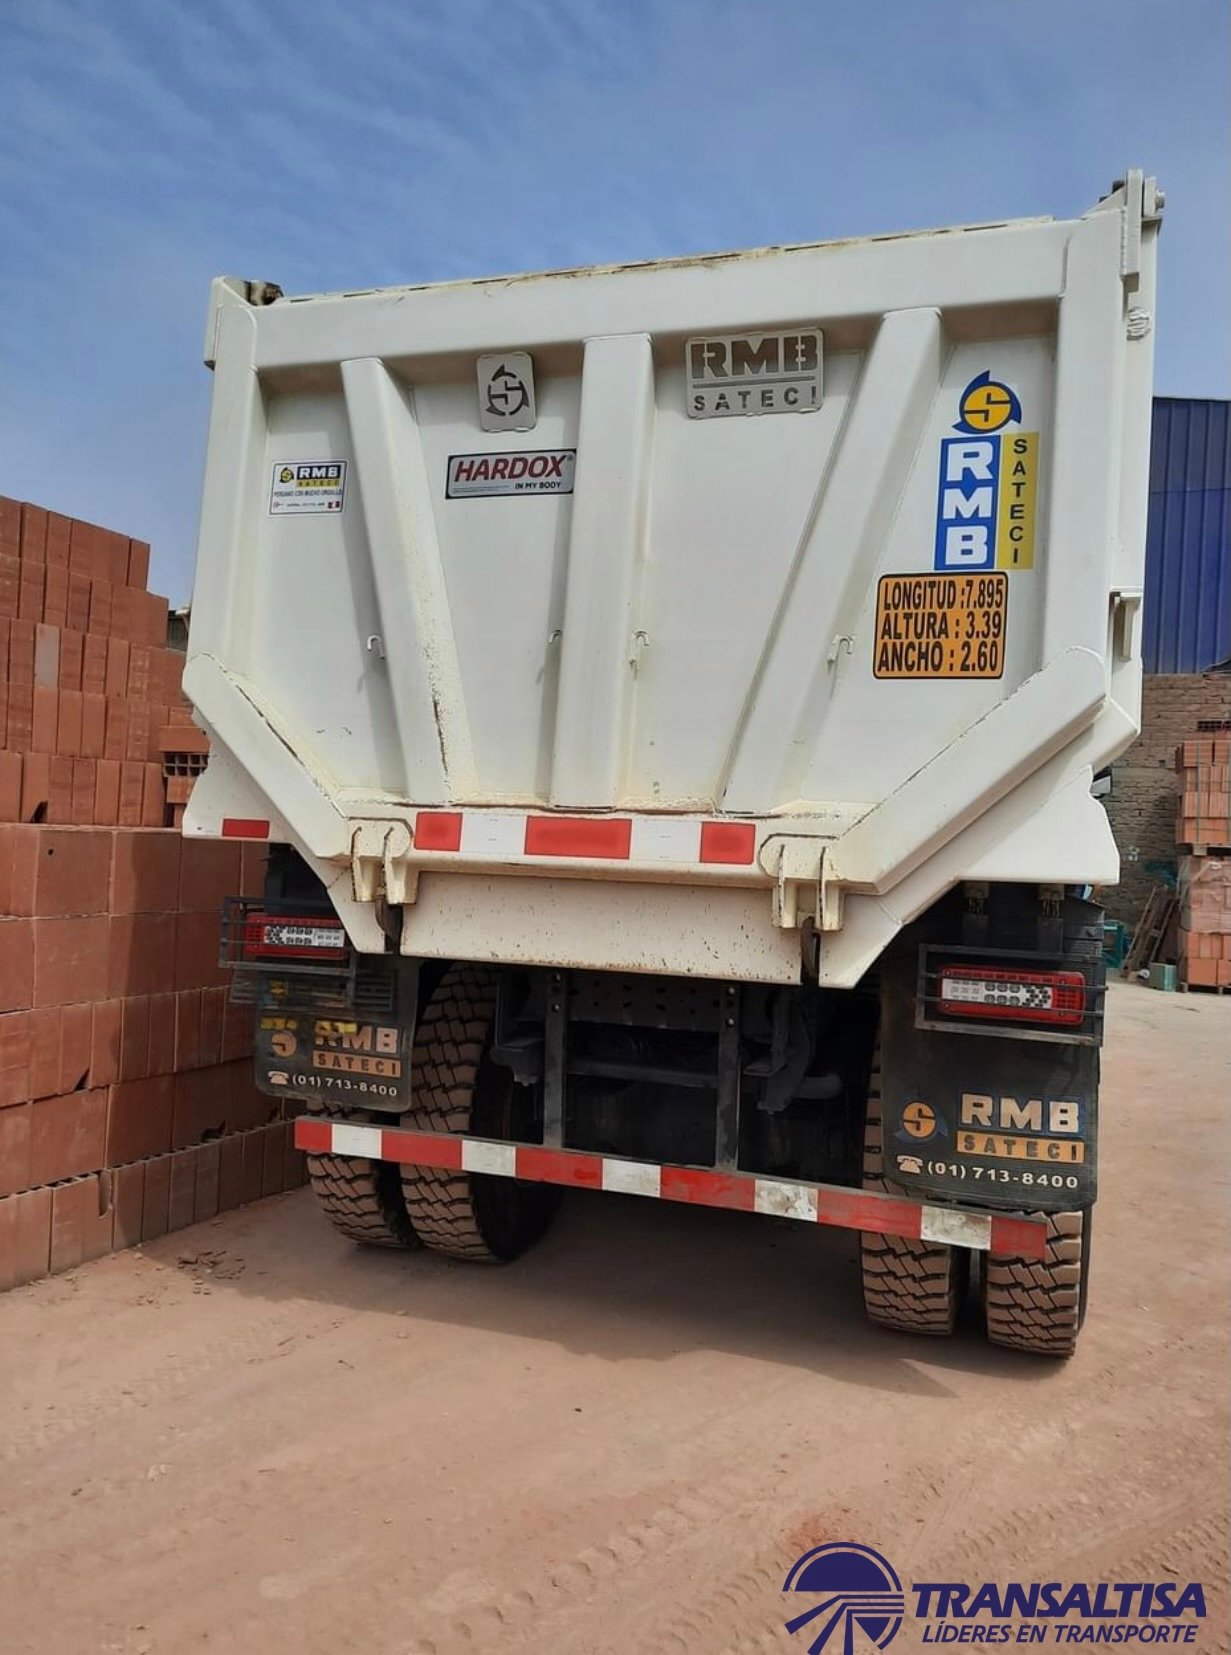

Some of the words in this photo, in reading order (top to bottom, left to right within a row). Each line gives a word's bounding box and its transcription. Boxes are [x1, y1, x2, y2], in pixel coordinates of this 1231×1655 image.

[690, 335, 818, 378] RMB
[693, 386, 817, 411] SATECI
[299, 466, 338, 478] RMB
[454, 454, 567, 482] HARDOX
[539, 481, 562, 489] BODY
[942, 441, 994, 565] RMB
[1008, 438, 1028, 563] SATECI
[883, 580, 956, 611] LONGITUD
[881, 611, 949, 640] ALTURA
[966, 610, 1001, 640] 3.39
[877, 641, 943, 673] ANCHO
[960, 641, 999, 672] 2.60
[317, 1053, 397, 1075] SATECI
[292, 1073, 322, 1088] (01)
[325, 1078, 398, 1097] 713-8400
[961, 1093, 1080, 1134] RMB
[963, 1134, 1078, 1161] SATECI
[927, 1160, 967, 1179] (01)
[972, 1167, 1079, 1189] 713-8400
